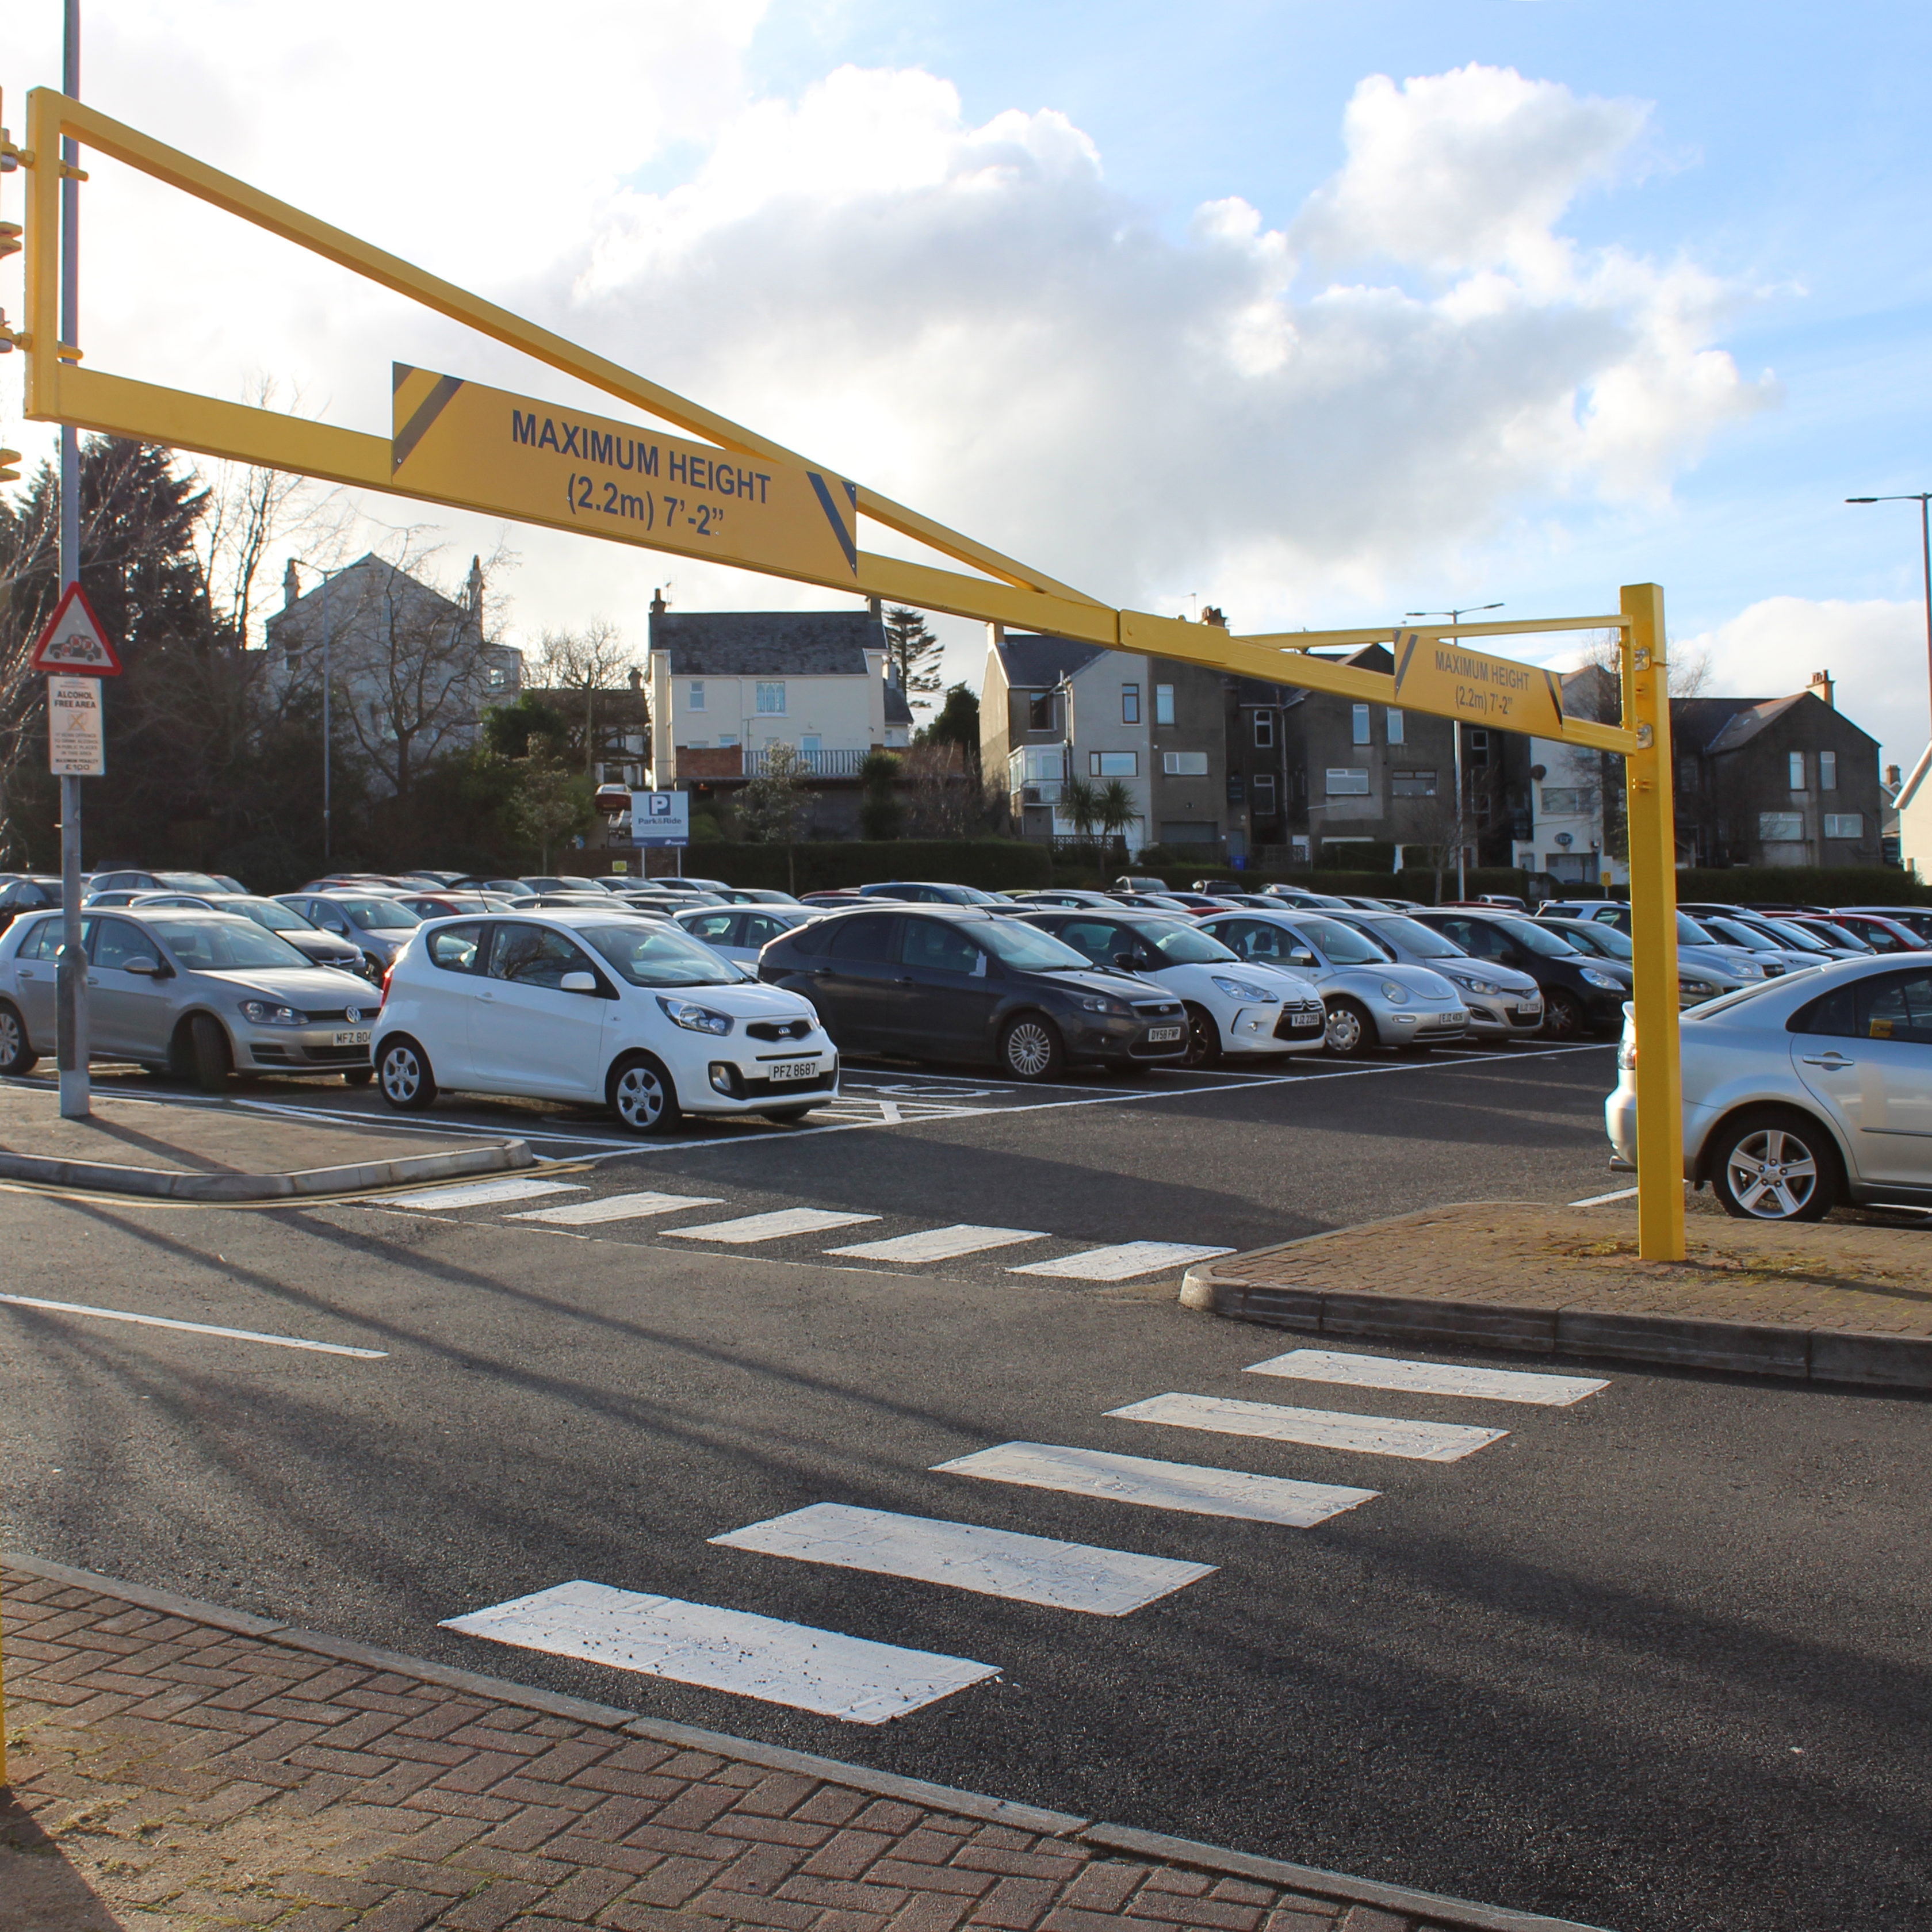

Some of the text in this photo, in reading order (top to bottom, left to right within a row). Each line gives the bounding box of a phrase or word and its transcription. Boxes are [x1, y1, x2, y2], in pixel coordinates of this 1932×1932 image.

[512, 410, 771, 503] MAXIMUM HEIGHT
[567, 473, 654, 531] (2.2m)
[1435, 651, 1529, 690] MAXIMUM HEIGHT
[54, 699, 97, 709] FREE AREA
[57, 690, 93, 699] ALCOHOL
[1456, 685, 1487, 715] (2.2m)
[651, 795, 668, 814] P
[336, 1032, 354, 1043] MFZ
[774, 1063, 816, 1078] PFZ 8687
